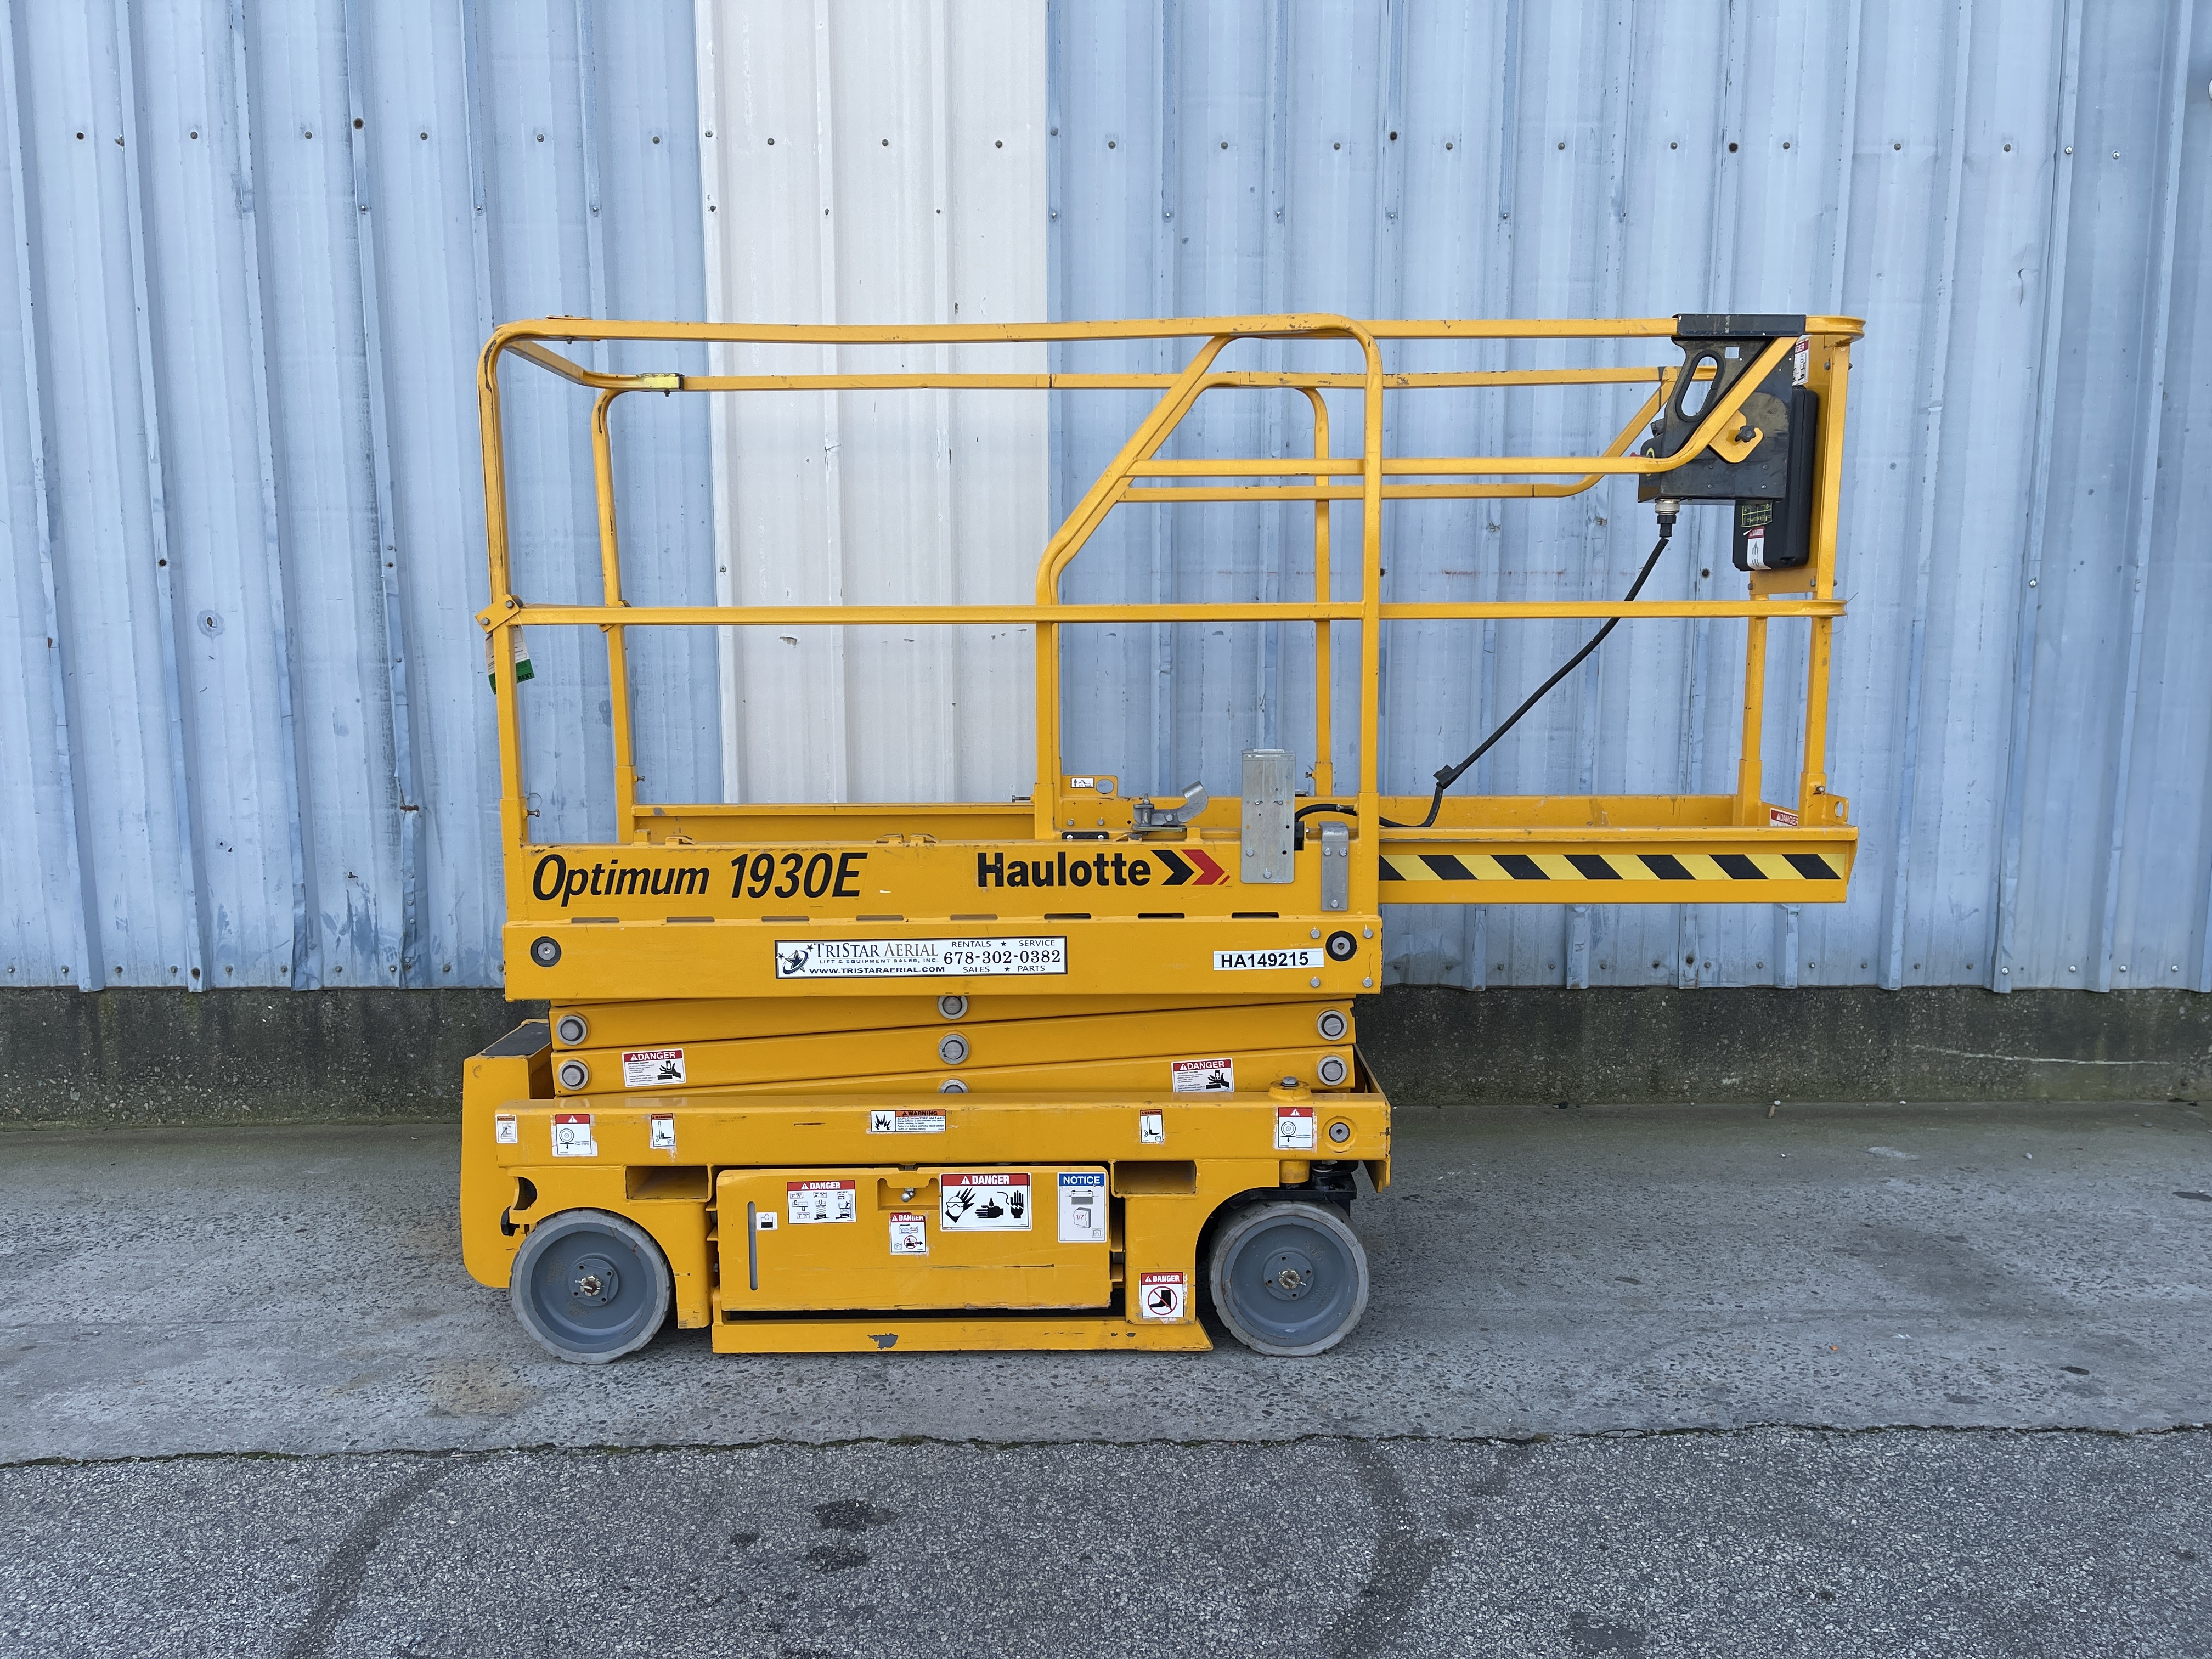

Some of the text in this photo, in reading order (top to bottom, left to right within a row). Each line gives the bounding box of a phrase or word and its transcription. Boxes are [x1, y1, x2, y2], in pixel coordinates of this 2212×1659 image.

[518, 672, 532, 681] RENT
[1780, 813, 1798, 825] DANGER
[977, 851, 1152, 888] Haulotte
[532, 852, 868, 907] Optimum 1930E
[944, 950, 1060, 964] 678-302-0382
[1221, 952, 1308, 968] HA149215
[637, 1051, 676, 1061] DANGER
[1187, 1060, 1225, 1070] DANGER
[972, 1175, 1010, 1184] DANGER
[1063, 1176, 1100, 1184] NOTICE
